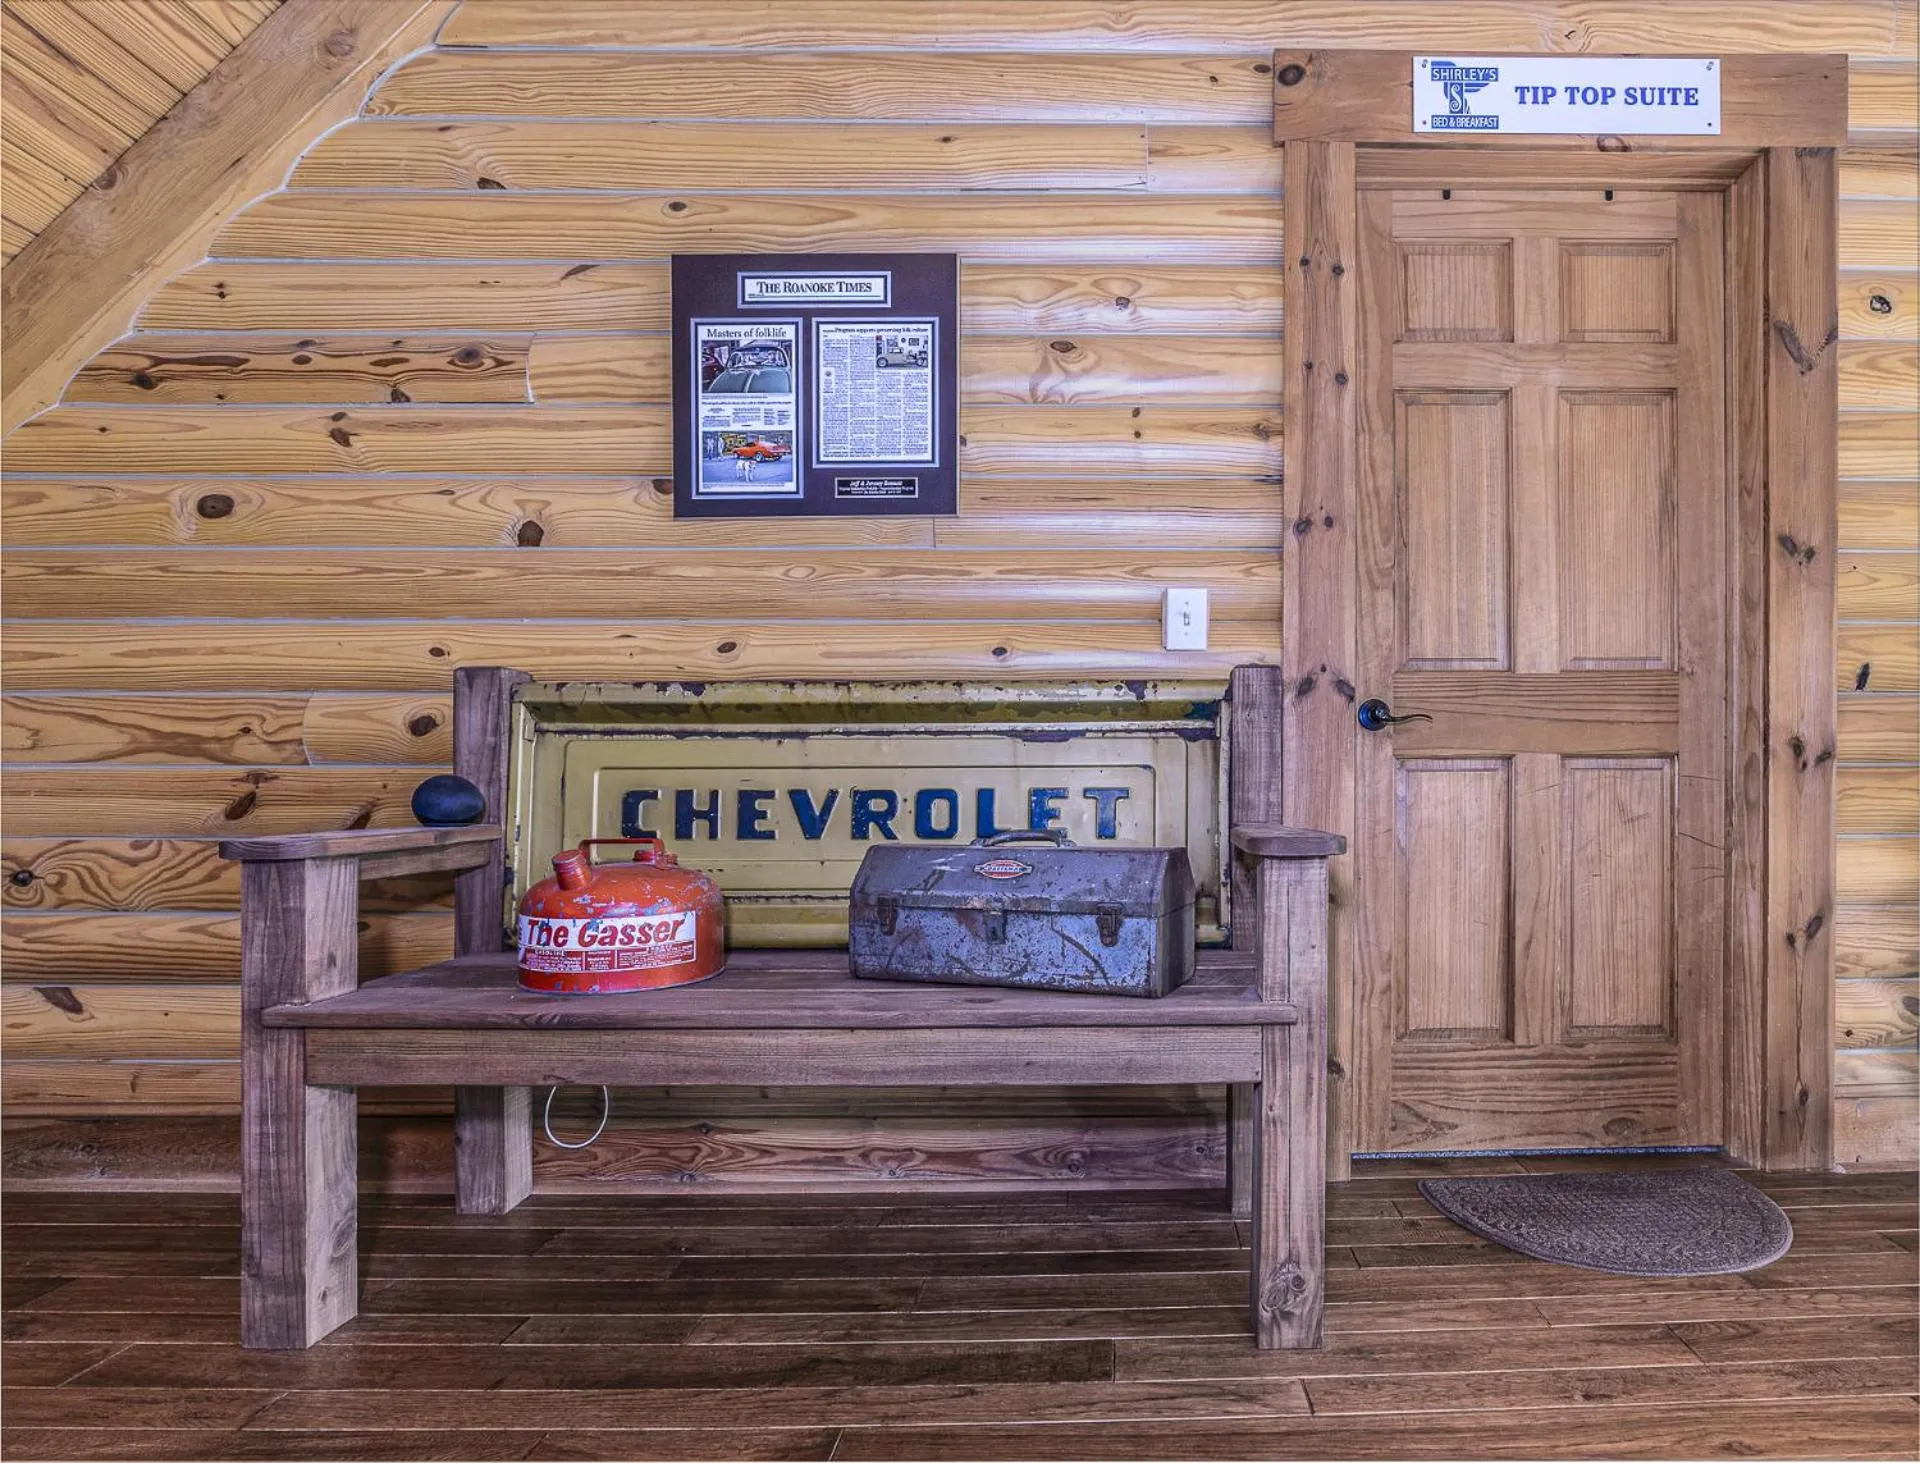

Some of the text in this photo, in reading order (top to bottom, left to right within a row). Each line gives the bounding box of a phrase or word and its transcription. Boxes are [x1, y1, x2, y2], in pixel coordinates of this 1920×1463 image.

[1431, 68, 1497, 81] SHIRLEY'S
[1515, 87, 1699, 106] TIP TOP SUITE
[1432, 116, 1499, 127] BED & BREAKFAST
[756, 281, 872, 294] THE ROANOKE TIMES
[707, 327, 787, 338] Masters of folklife
[621, 787, 1130, 841] CHEVROLET
[528, 919, 569, 948] The
[578, 918, 686, 948] Gasser
